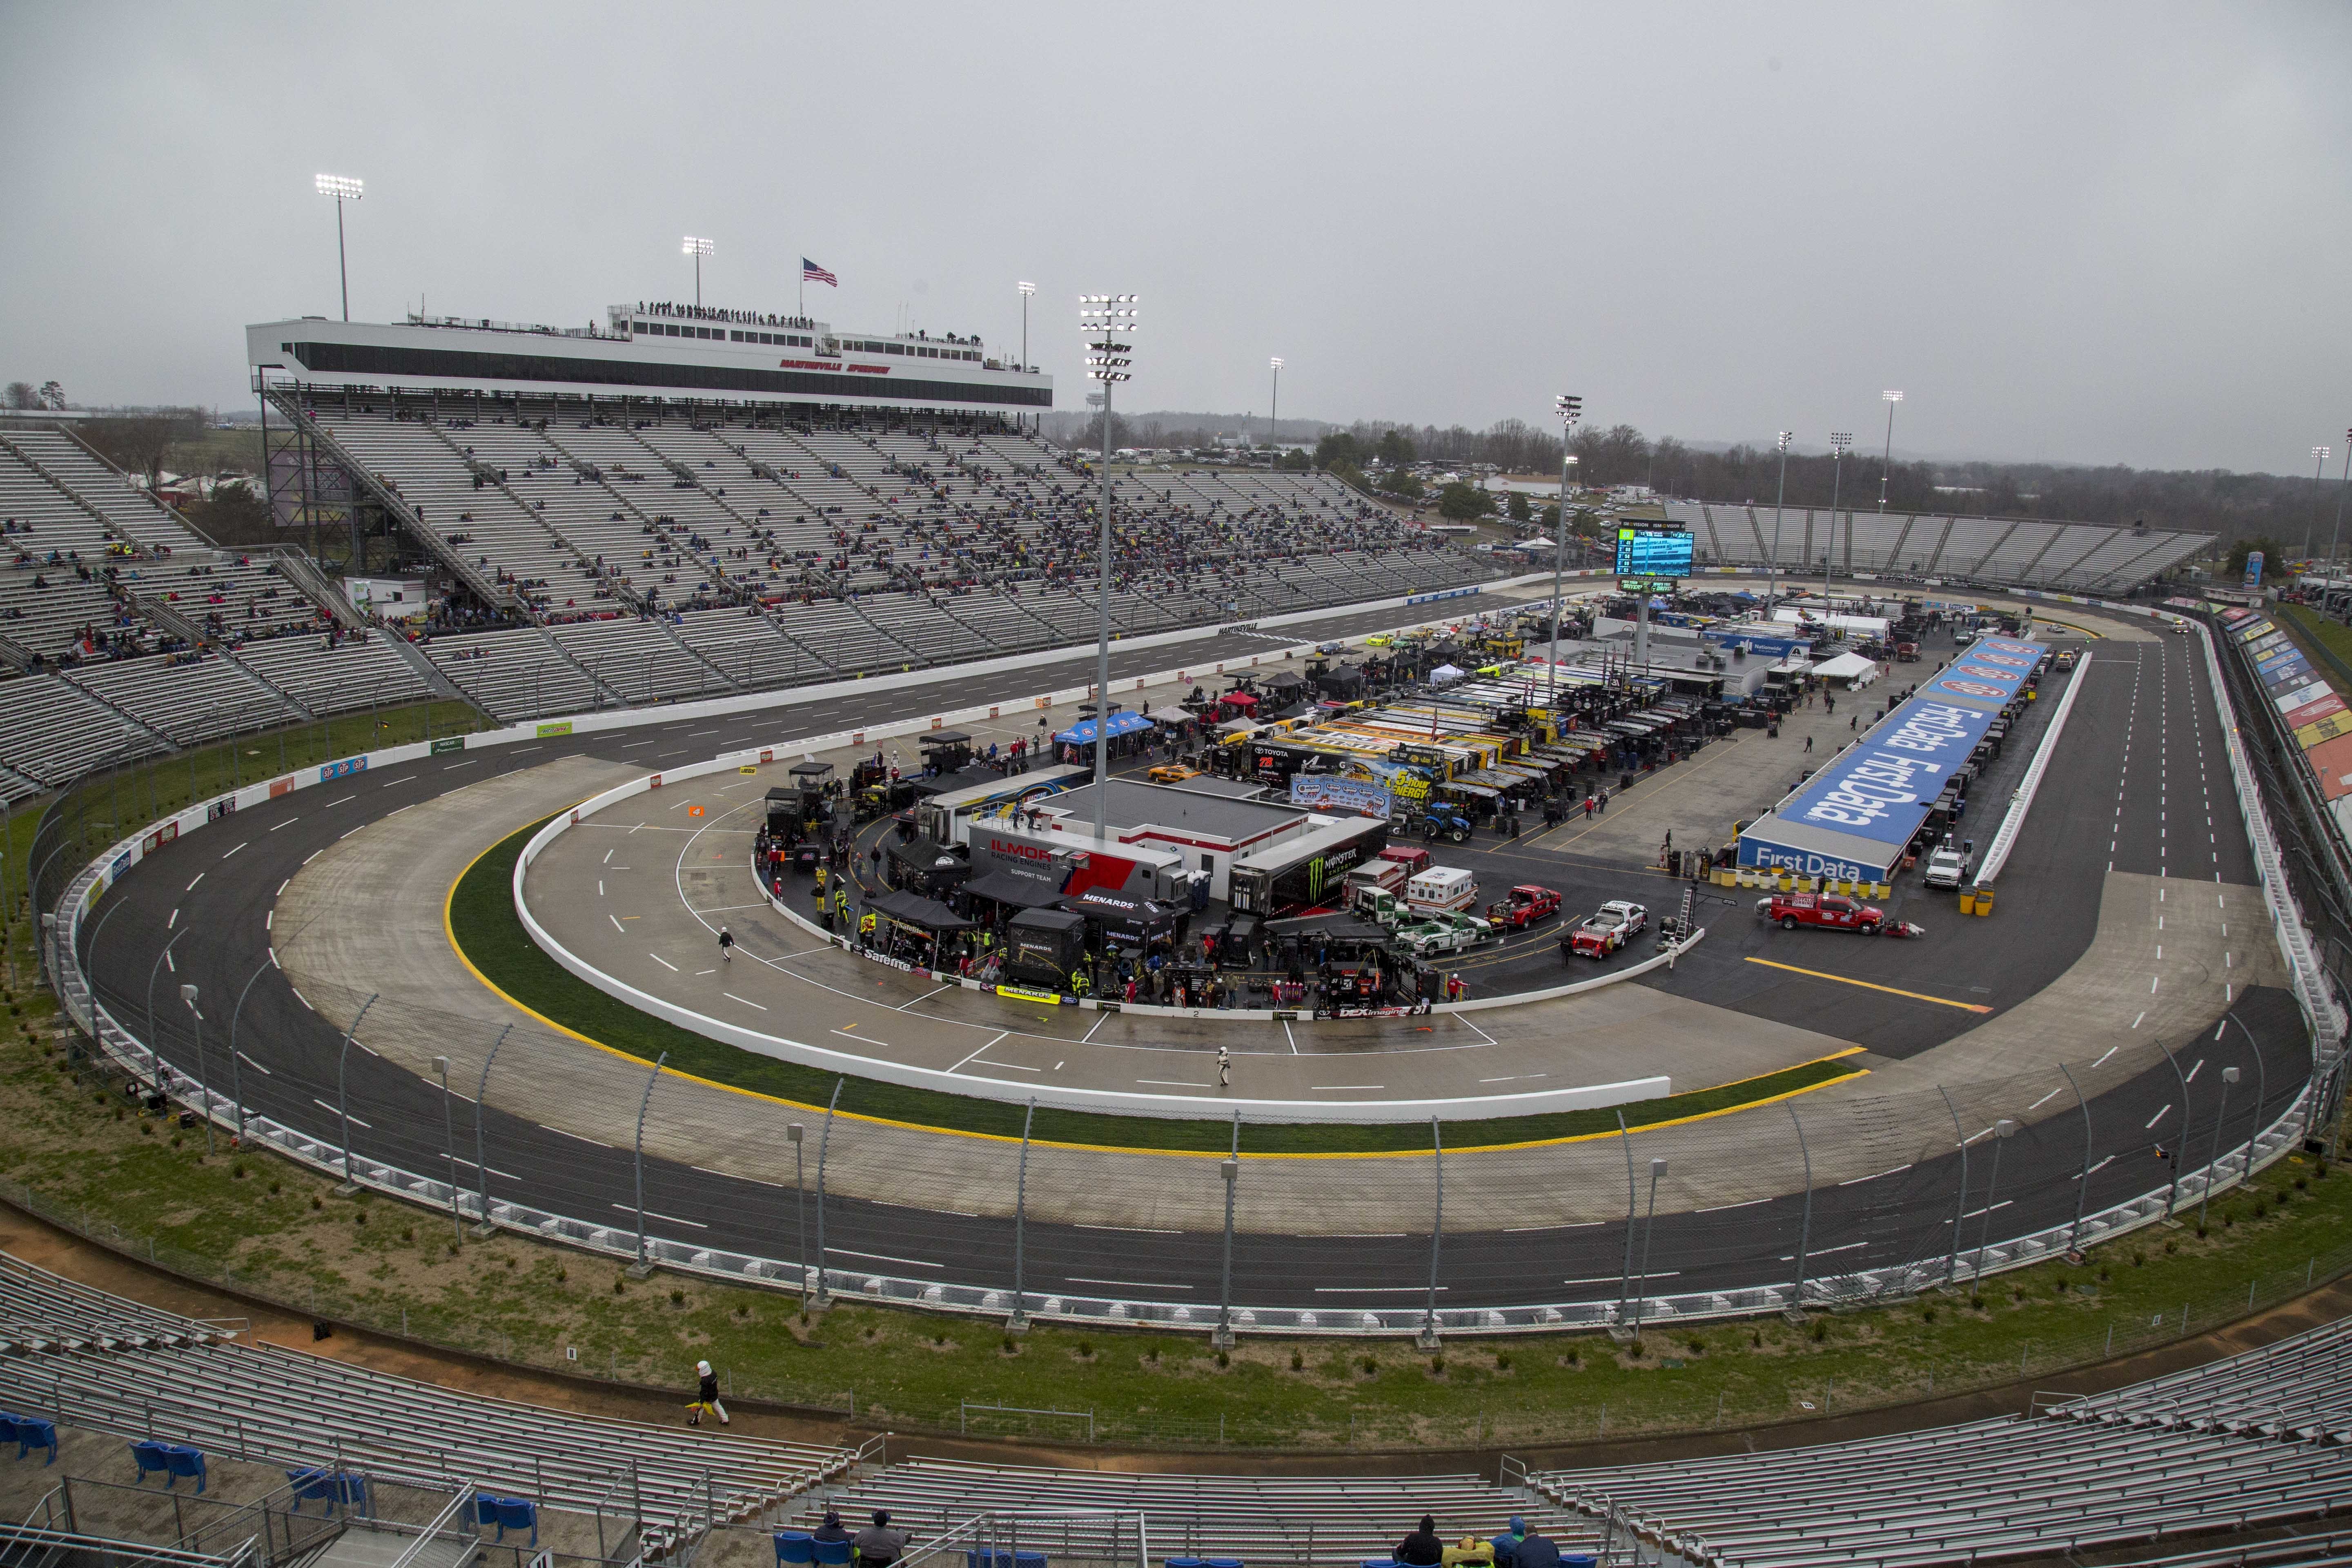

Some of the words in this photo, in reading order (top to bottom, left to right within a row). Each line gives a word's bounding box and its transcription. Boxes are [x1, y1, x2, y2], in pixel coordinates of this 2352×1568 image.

[780, 359, 842, 371] MARTINSVILLE
[846, 364, 891, 374] SPEEDWAY
[1218, 623, 1258, 636] MARTINSVILLE
[1982, 655, 2023, 665] STP
[1968, 667, 2011, 678] STP
[1951, 682, 1999, 695] STP
[1910, 703, 1983, 728] First
[1885, 721, 1968, 751] Data
[1264, 748, 1288, 757] TOYOTA
[355, 759, 364, 769] STP
[1259, 757, 1273, 767] 78
[324, 768, 333, 778] STP
[339, 764, 349, 774] STP
[1847, 752, 1942, 788] First
[1395, 771, 1430, 789] 5-hour
[1394, 785, 1428, 799] ENERGY
[1807, 780, 1918, 825] Data
[991, 839, 1051, 862] ILMOR
[991, 852, 1018, 863] RACING
[1020, 858, 1051, 871] ENGINES
[1325, 849, 1356, 869] MONSTER
[1756, 847, 1803, 871] First
[1806, 854, 1860, 880] Data
[1011, 869, 1034, 879] SUPPORT
[1329, 862, 1352, 876] ENERGY
[1083, 894, 1134, 909] MENARDS
[1107, 931, 1139, 941] MENARDS
[1151, 929, 1171, 941] MENADS
[1020, 943, 1052, 951] MENARDS
[864, 949, 911, 971] Safelite
[1004, 987, 1051, 999] MENARDS
[1368, 1008, 1406, 1016] imaging
[1413, 1006, 1427, 1015] 51
